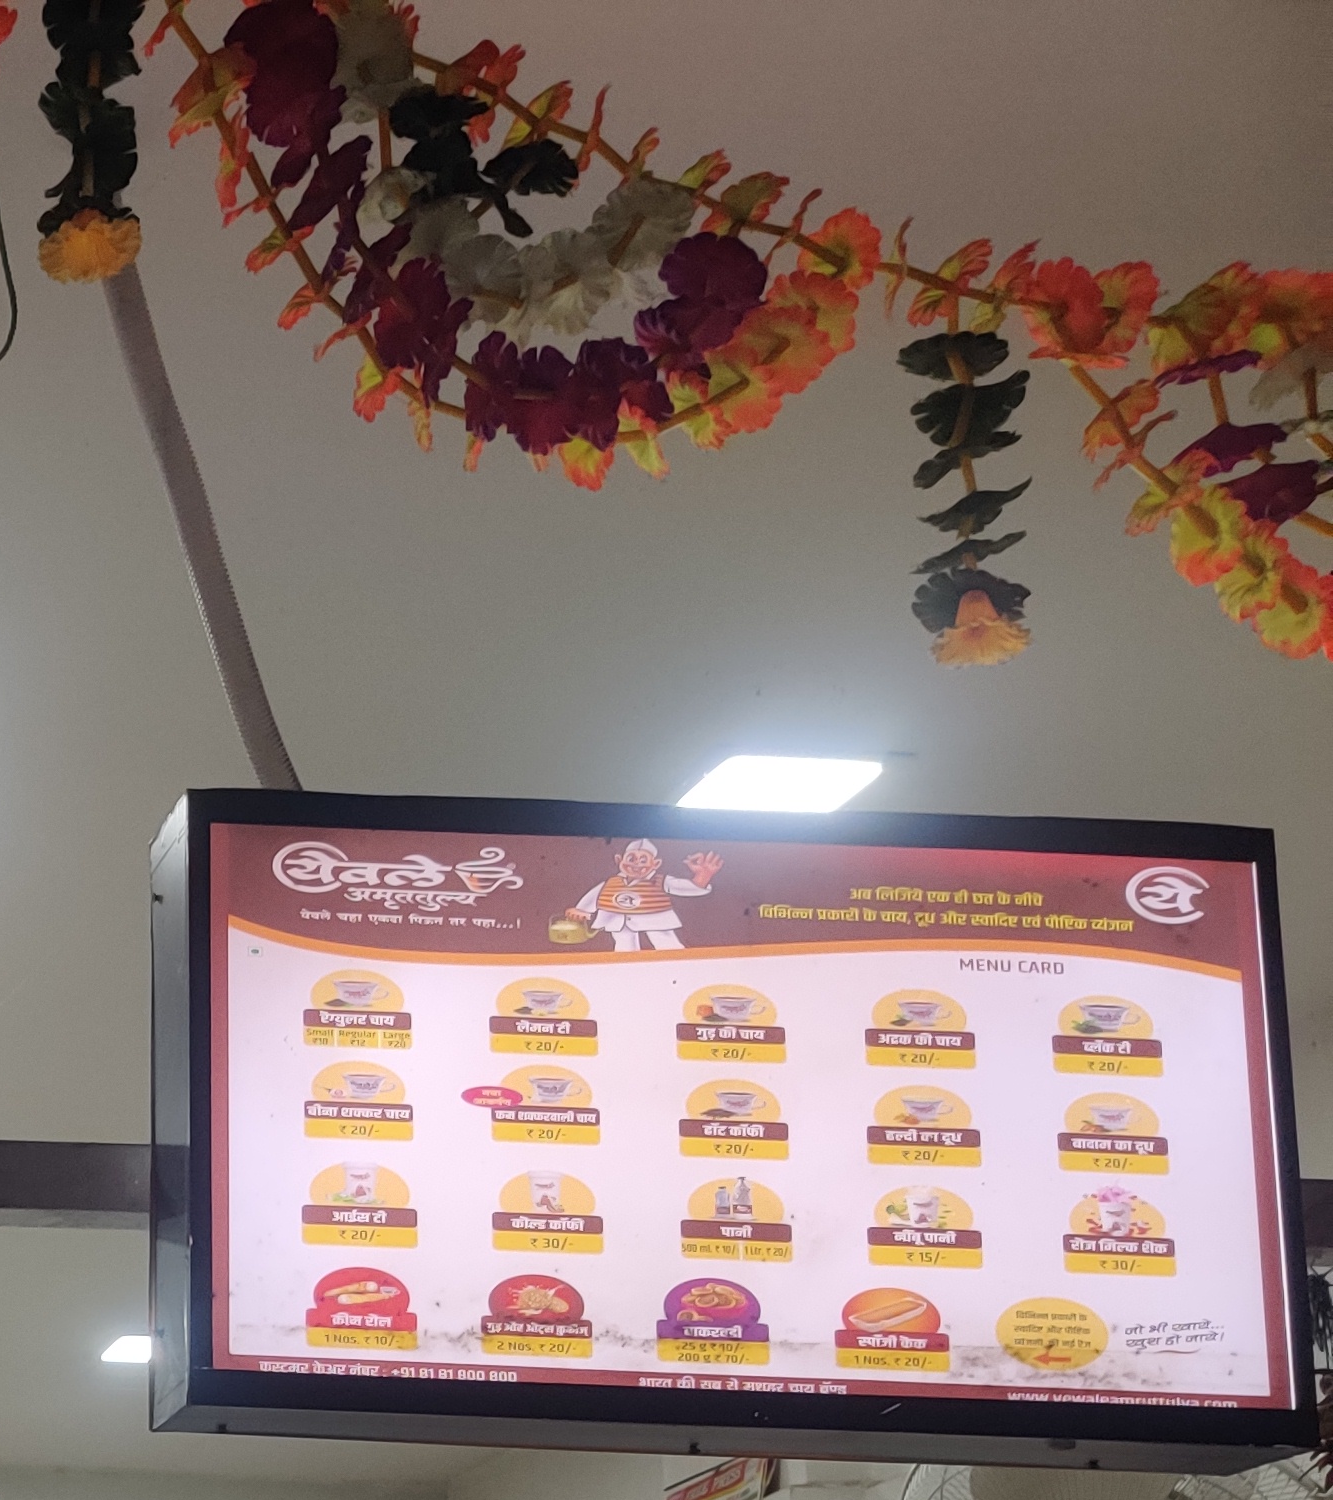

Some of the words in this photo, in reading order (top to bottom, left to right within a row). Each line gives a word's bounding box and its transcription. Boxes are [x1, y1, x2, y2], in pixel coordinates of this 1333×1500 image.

[344, 887, 487, 911] अमृततुल्य
[850, 888, 872, 900] अब
[927, 891, 950, 902] एक
[954, 889, 968, 904] ही
[972, 893, 993, 905] छत
[997, 891, 1010, 905] के
[1015, 891, 1043, 907] नीचे
[759, 904, 813, 919] विभिन्न
[863, 907, 877, 921] के
[880, 910, 912, 925] चाय,
[915, 912, 935, 927] दूध
[940, 911, 967, 925] और
[1022, 916, 1041, 928] एवं
[1091, 918, 1133, 932] व्यंजन
[960, 958, 1011, 973] MENU
[1017, 961, 1065, 975] CARD
[369, 1015, 396, 1026] चाय
[306, 1028, 334, 1036] Small
[339, 1030, 375, 1038] Regular
[515, 1021, 554, 1034] लेमन
[557, 1021, 571, 1034] टी
[719, 1027, 737, 1040] की
[740, 1028, 766, 1040] चाय
[914, 1032, 932, 1046] की
[935, 1035, 962, 1046] चाय
[1115, 1040, 1131, 1054] टी
[385, 1107, 410, 1120] चाय
[495, 1110, 515, 1120] कम
[576, 1113, 596, 1123] चाय
[885, 1128, 917, 1143] हल्दी
[920, 1129, 939, 1142] का
[941, 1131, 962, 1145] दूध
[1113, 1139, 1131, 1151] का
[1133, 1139, 1154, 1154] दूध
[372, 1211, 387, 1224] टी
[512, 1217, 547, 1230] कोल्ड
[549, 1216, 584, 1232] कॉफी
[720, 1225, 752, 1238] पानी
[924, 1231, 956, 1244] पानी
[1070, 1239, 1096, 1252] रोज
[1099, 1240, 1139, 1254] मिल्क
[366, 1313, 392, 1327] रोल
[1125, 1325, 1144, 1335] जो
[1149, 1322, 1168, 1333] भी
[899, 1336, 928, 1349] केक
[1166, 1336, 1180, 1345] हो
